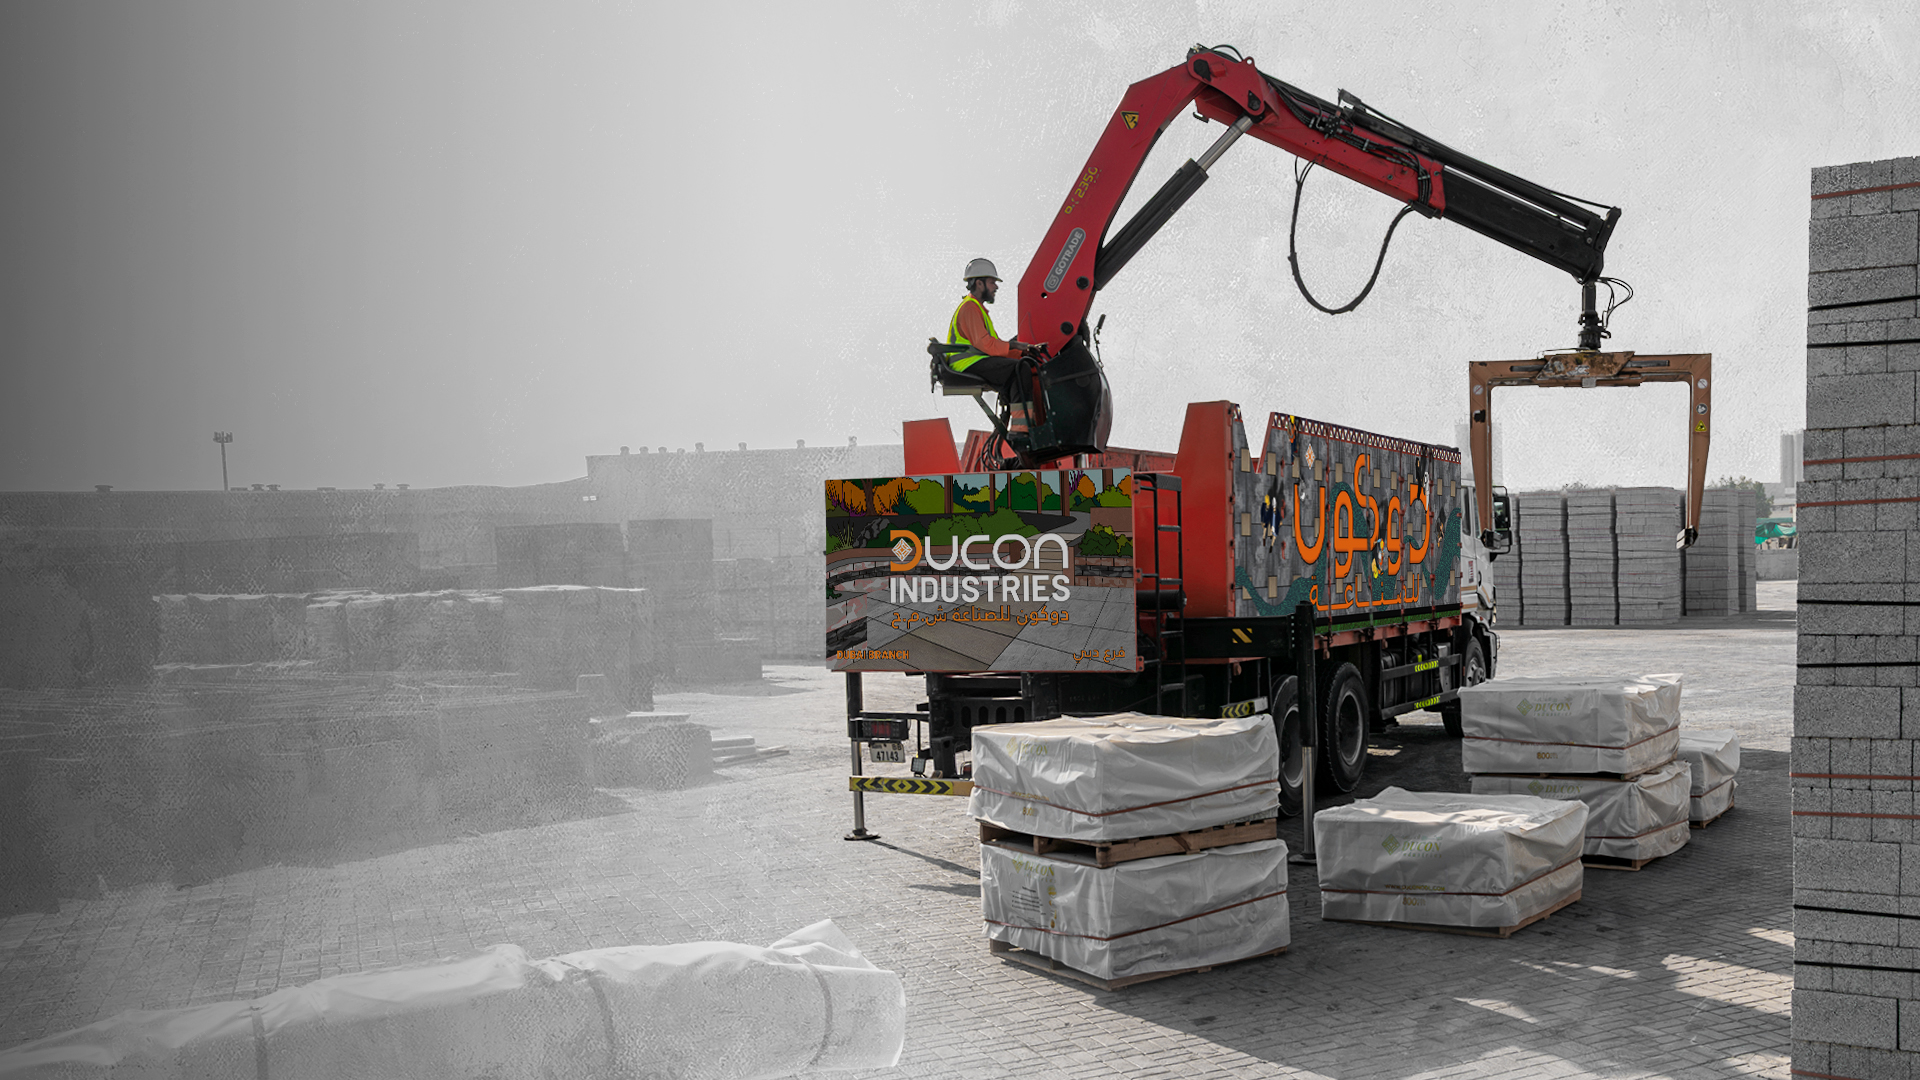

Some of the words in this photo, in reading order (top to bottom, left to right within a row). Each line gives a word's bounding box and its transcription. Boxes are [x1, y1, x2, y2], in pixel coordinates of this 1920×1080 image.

[1055, 231, 1084, 276] GOTRADE
[889, 529, 1069, 571] DUCON
[890, 574, 1071, 604] INDUSTRIES
[1309, 573, 1421, 612] للصناعة
[951, 604, 1011, 622] للصناعة
[1016, 605, 1070, 627] دوكون
[836, 649, 866, 660] DUBAI
[868, 649, 910, 660] BRANCH
[1073, 649, 1100, 664] دبي
[1103, 646, 1126, 663] فرع
[1534, 702, 1572, 712] DUCON
[876, 750, 899, 762] 47143
[1545, 783, 1583, 794] DUCON
[1401, 840, 1442, 853] DUCON
